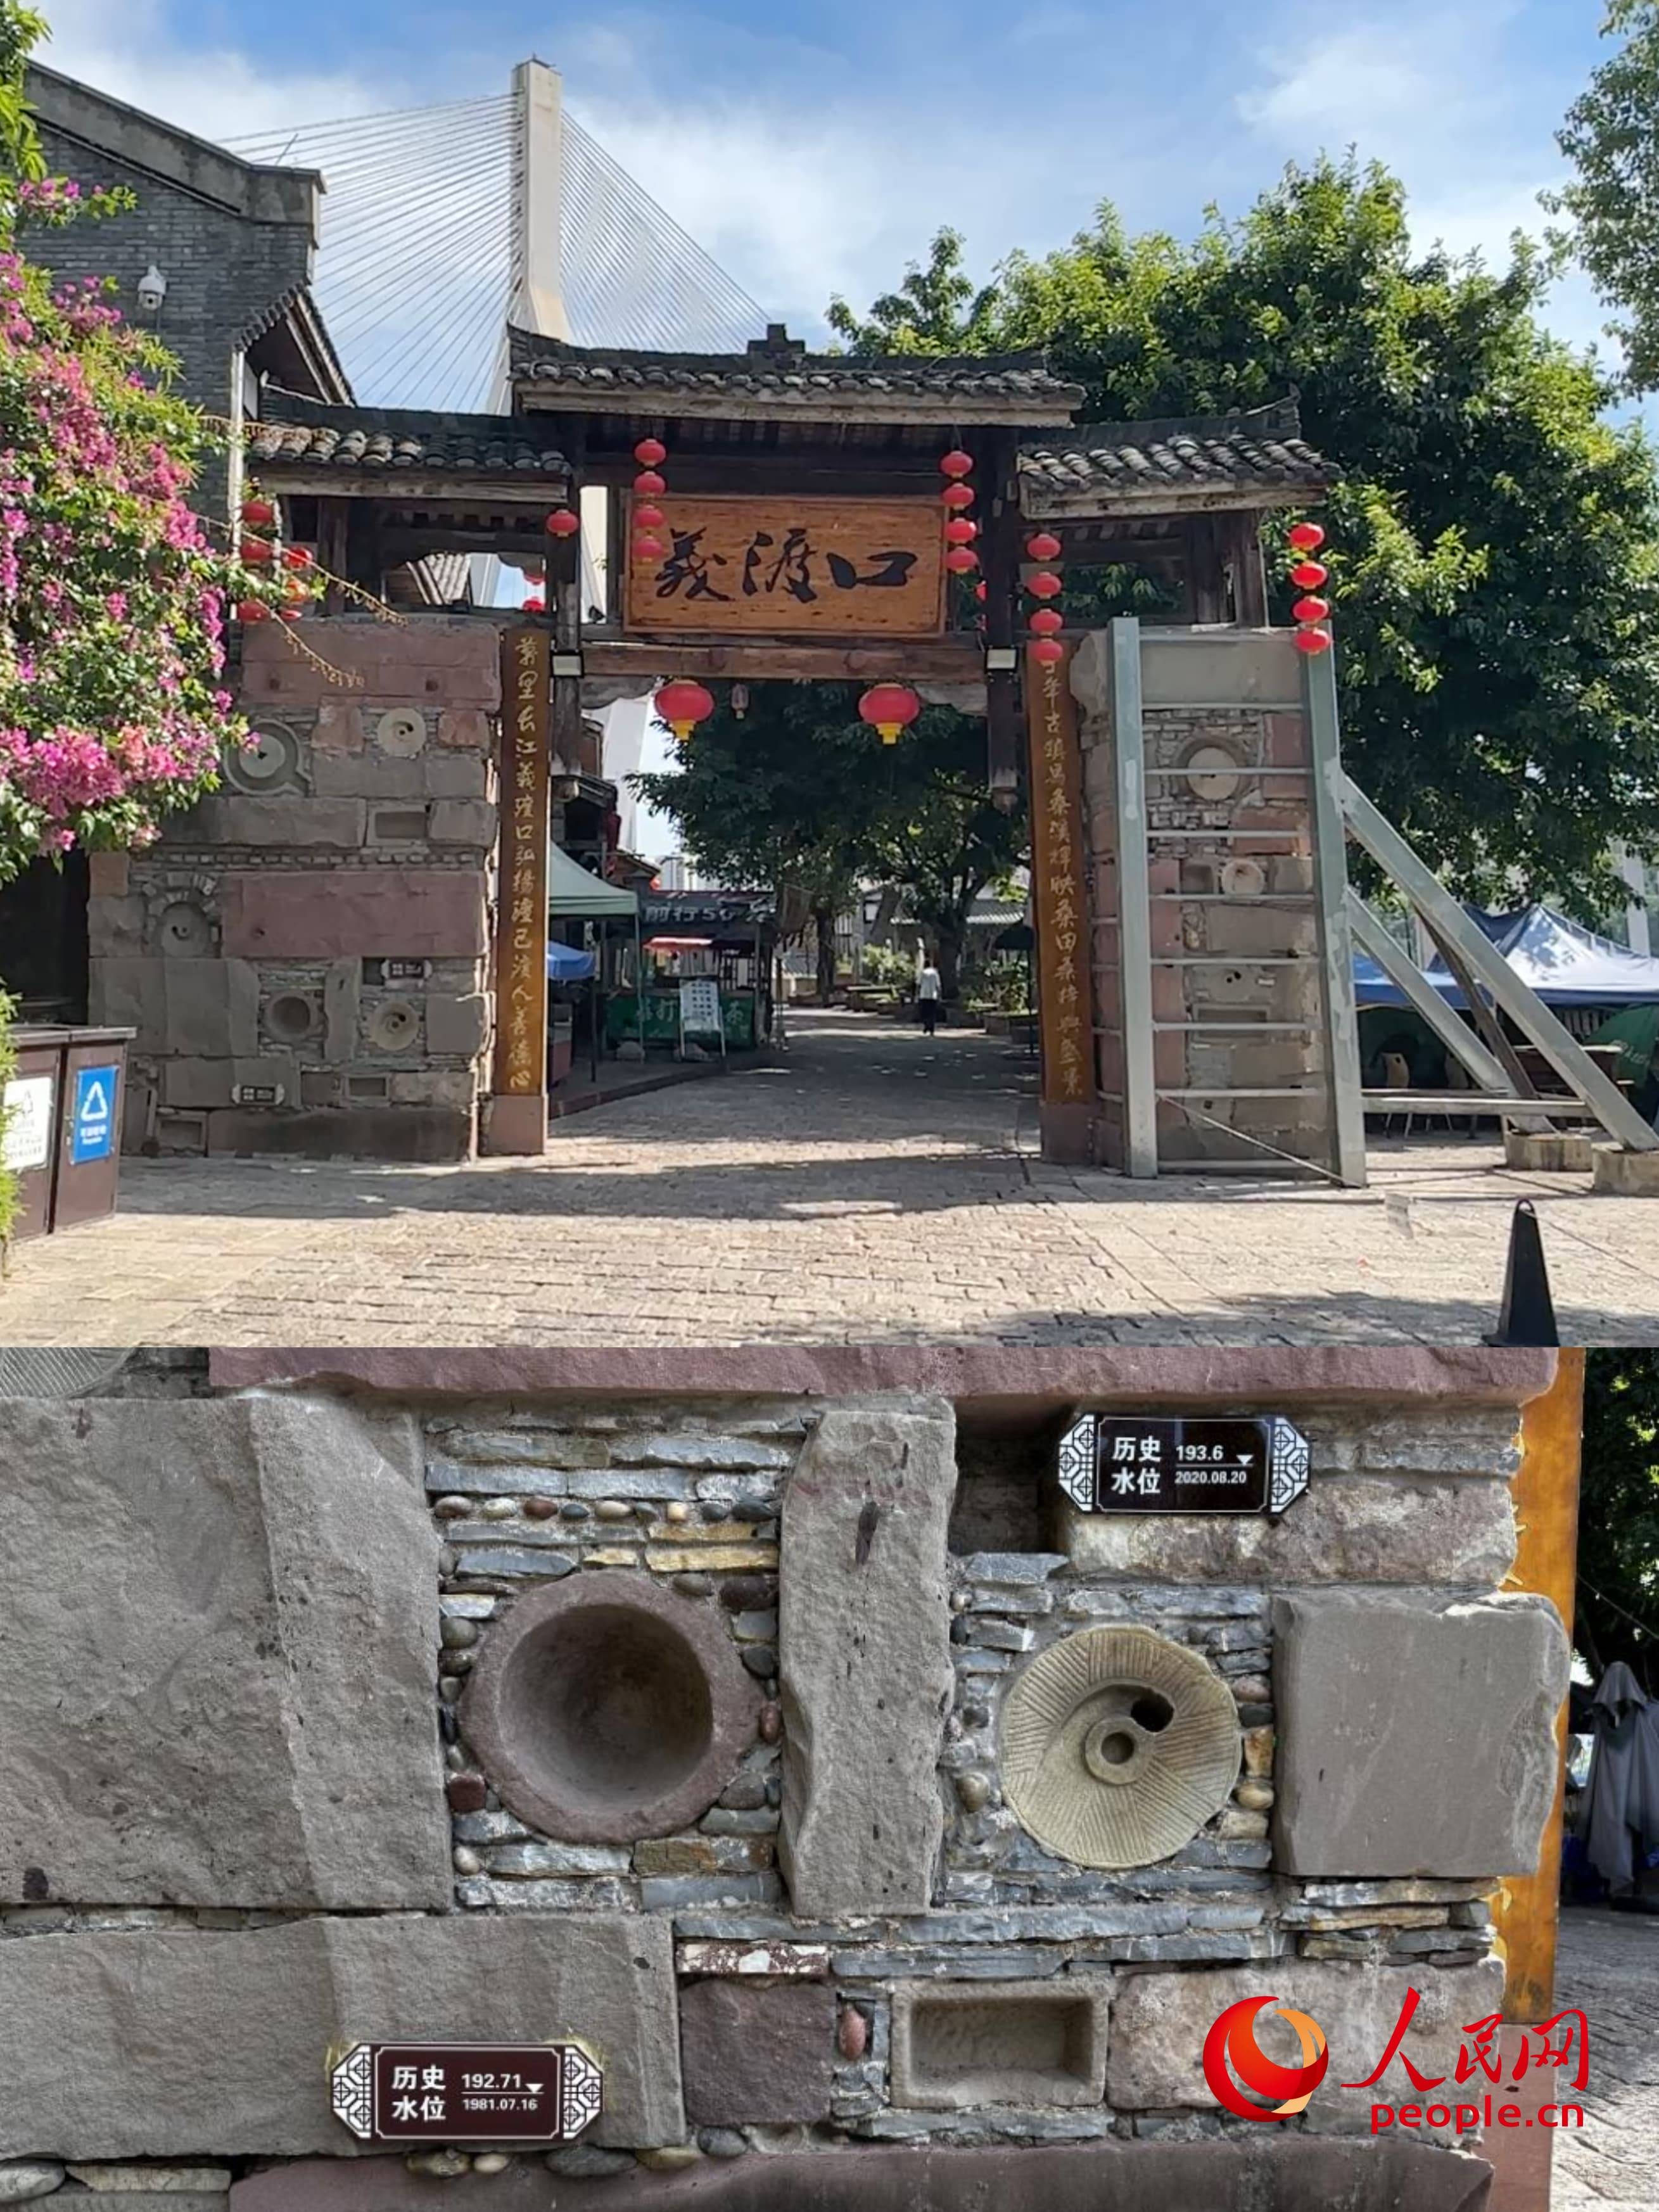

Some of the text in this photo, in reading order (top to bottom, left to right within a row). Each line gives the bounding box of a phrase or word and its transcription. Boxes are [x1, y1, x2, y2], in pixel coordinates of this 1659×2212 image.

[1112, 1435, 1161, 1461] 历史
[1176, 1445, 1224, 1461] 193.6
[1111, 1468, 1161, 1495] 水位
[1174, 1470, 1247, 1484] 2020.08.20
[391, 2064, 446, 2090] 历史
[461, 2073, 521, 2088] 192.71
[391, 2095, 447, 2121] 水位
[462, 2098, 538, 2111] 1981.07.16
